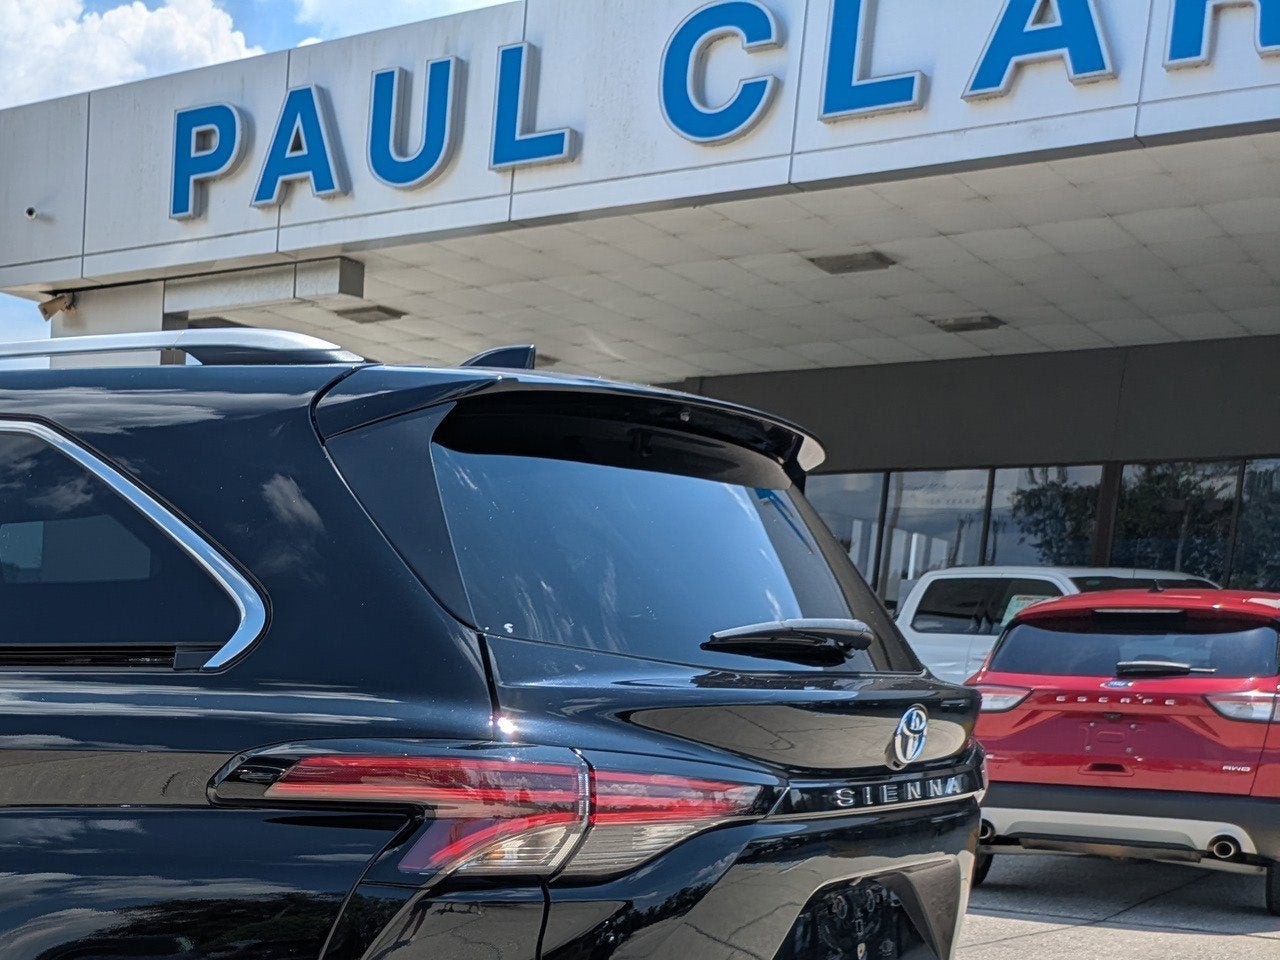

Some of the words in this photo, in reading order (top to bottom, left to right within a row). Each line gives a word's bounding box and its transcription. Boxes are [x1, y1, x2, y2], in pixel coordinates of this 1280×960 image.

[168, 41, 577, 220] PAUL
[1056, 695, 1176, 706] ESCAPE
[1222, 764, 1251, 773] AWD
[836, 776, 964, 807] SIENNA
